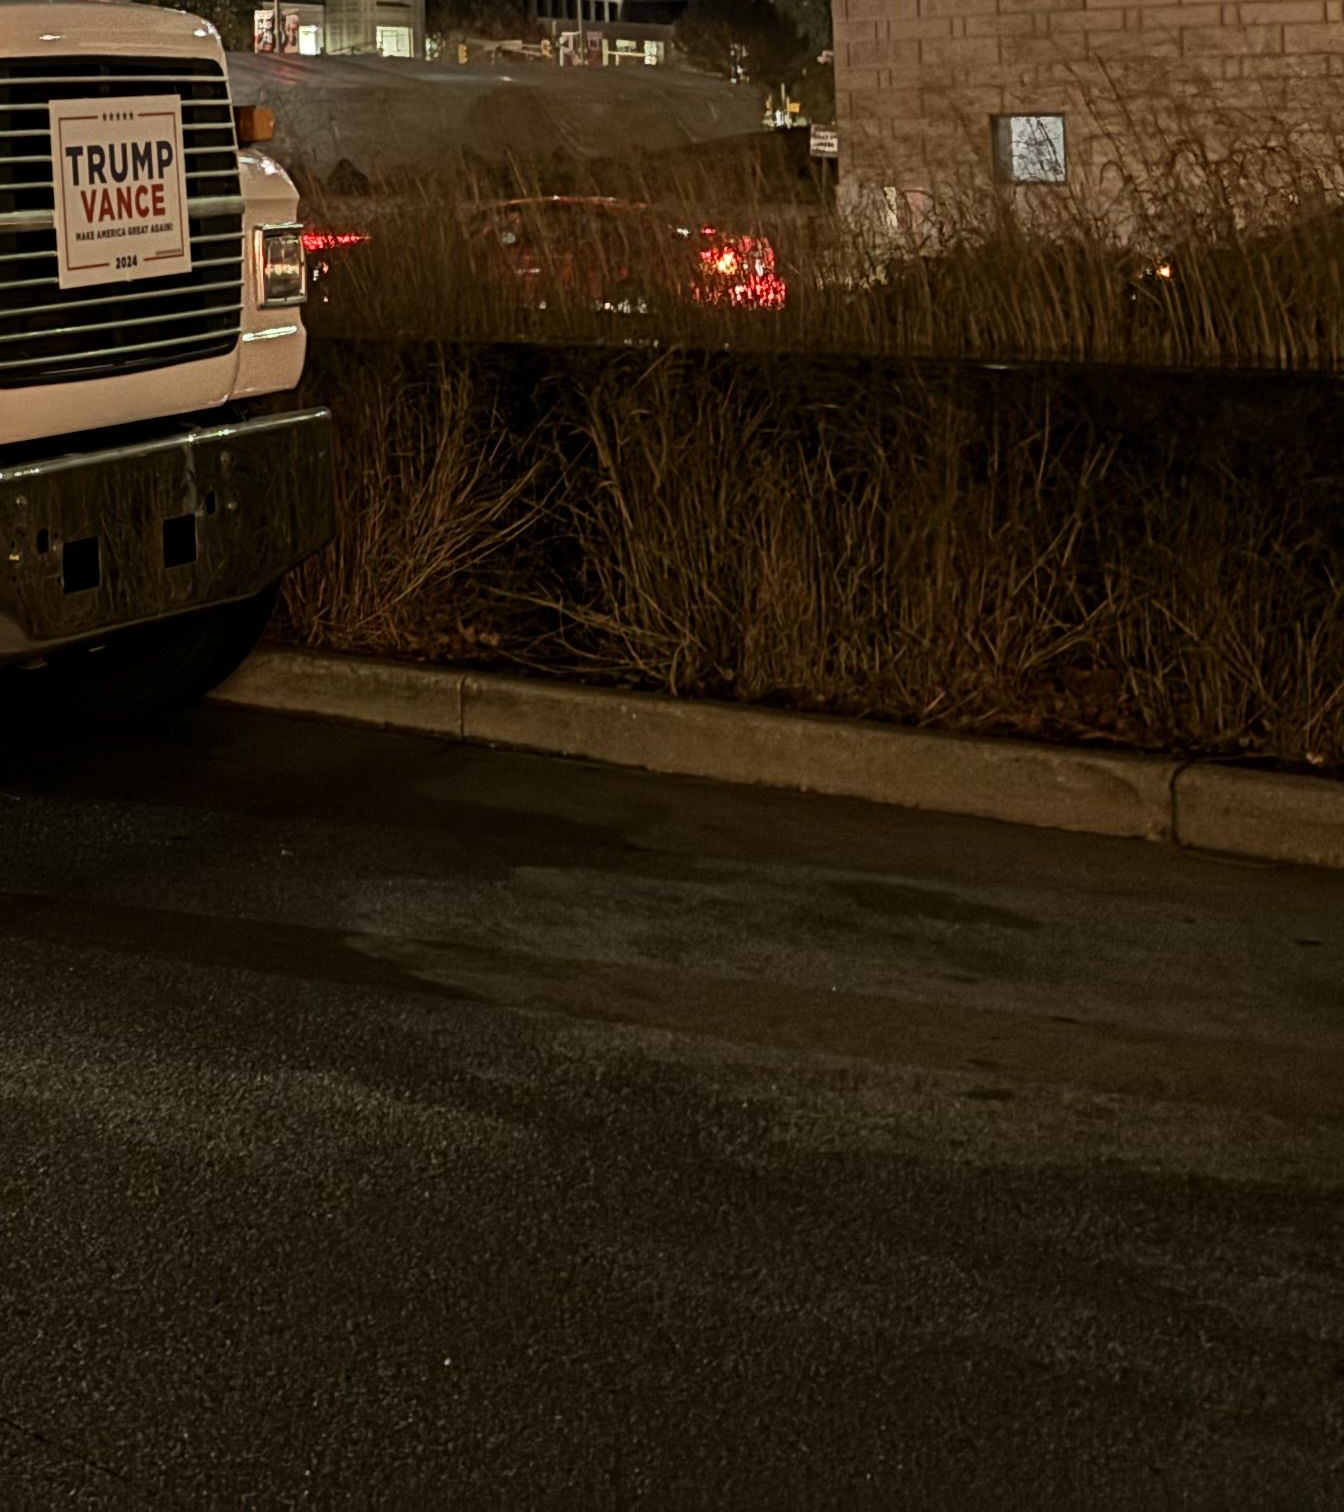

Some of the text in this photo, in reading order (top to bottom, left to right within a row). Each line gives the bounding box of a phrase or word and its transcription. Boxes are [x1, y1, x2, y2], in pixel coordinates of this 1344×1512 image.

[65, 140, 173, 186] TRUMP
[81, 183, 166, 223] VANCE
[76, 231, 95, 241] MAKE
[97, 227, 126, 239] AMERICA
[128, 224, 149, 236] GREAT
[115, 254, 138, 269] 2024
